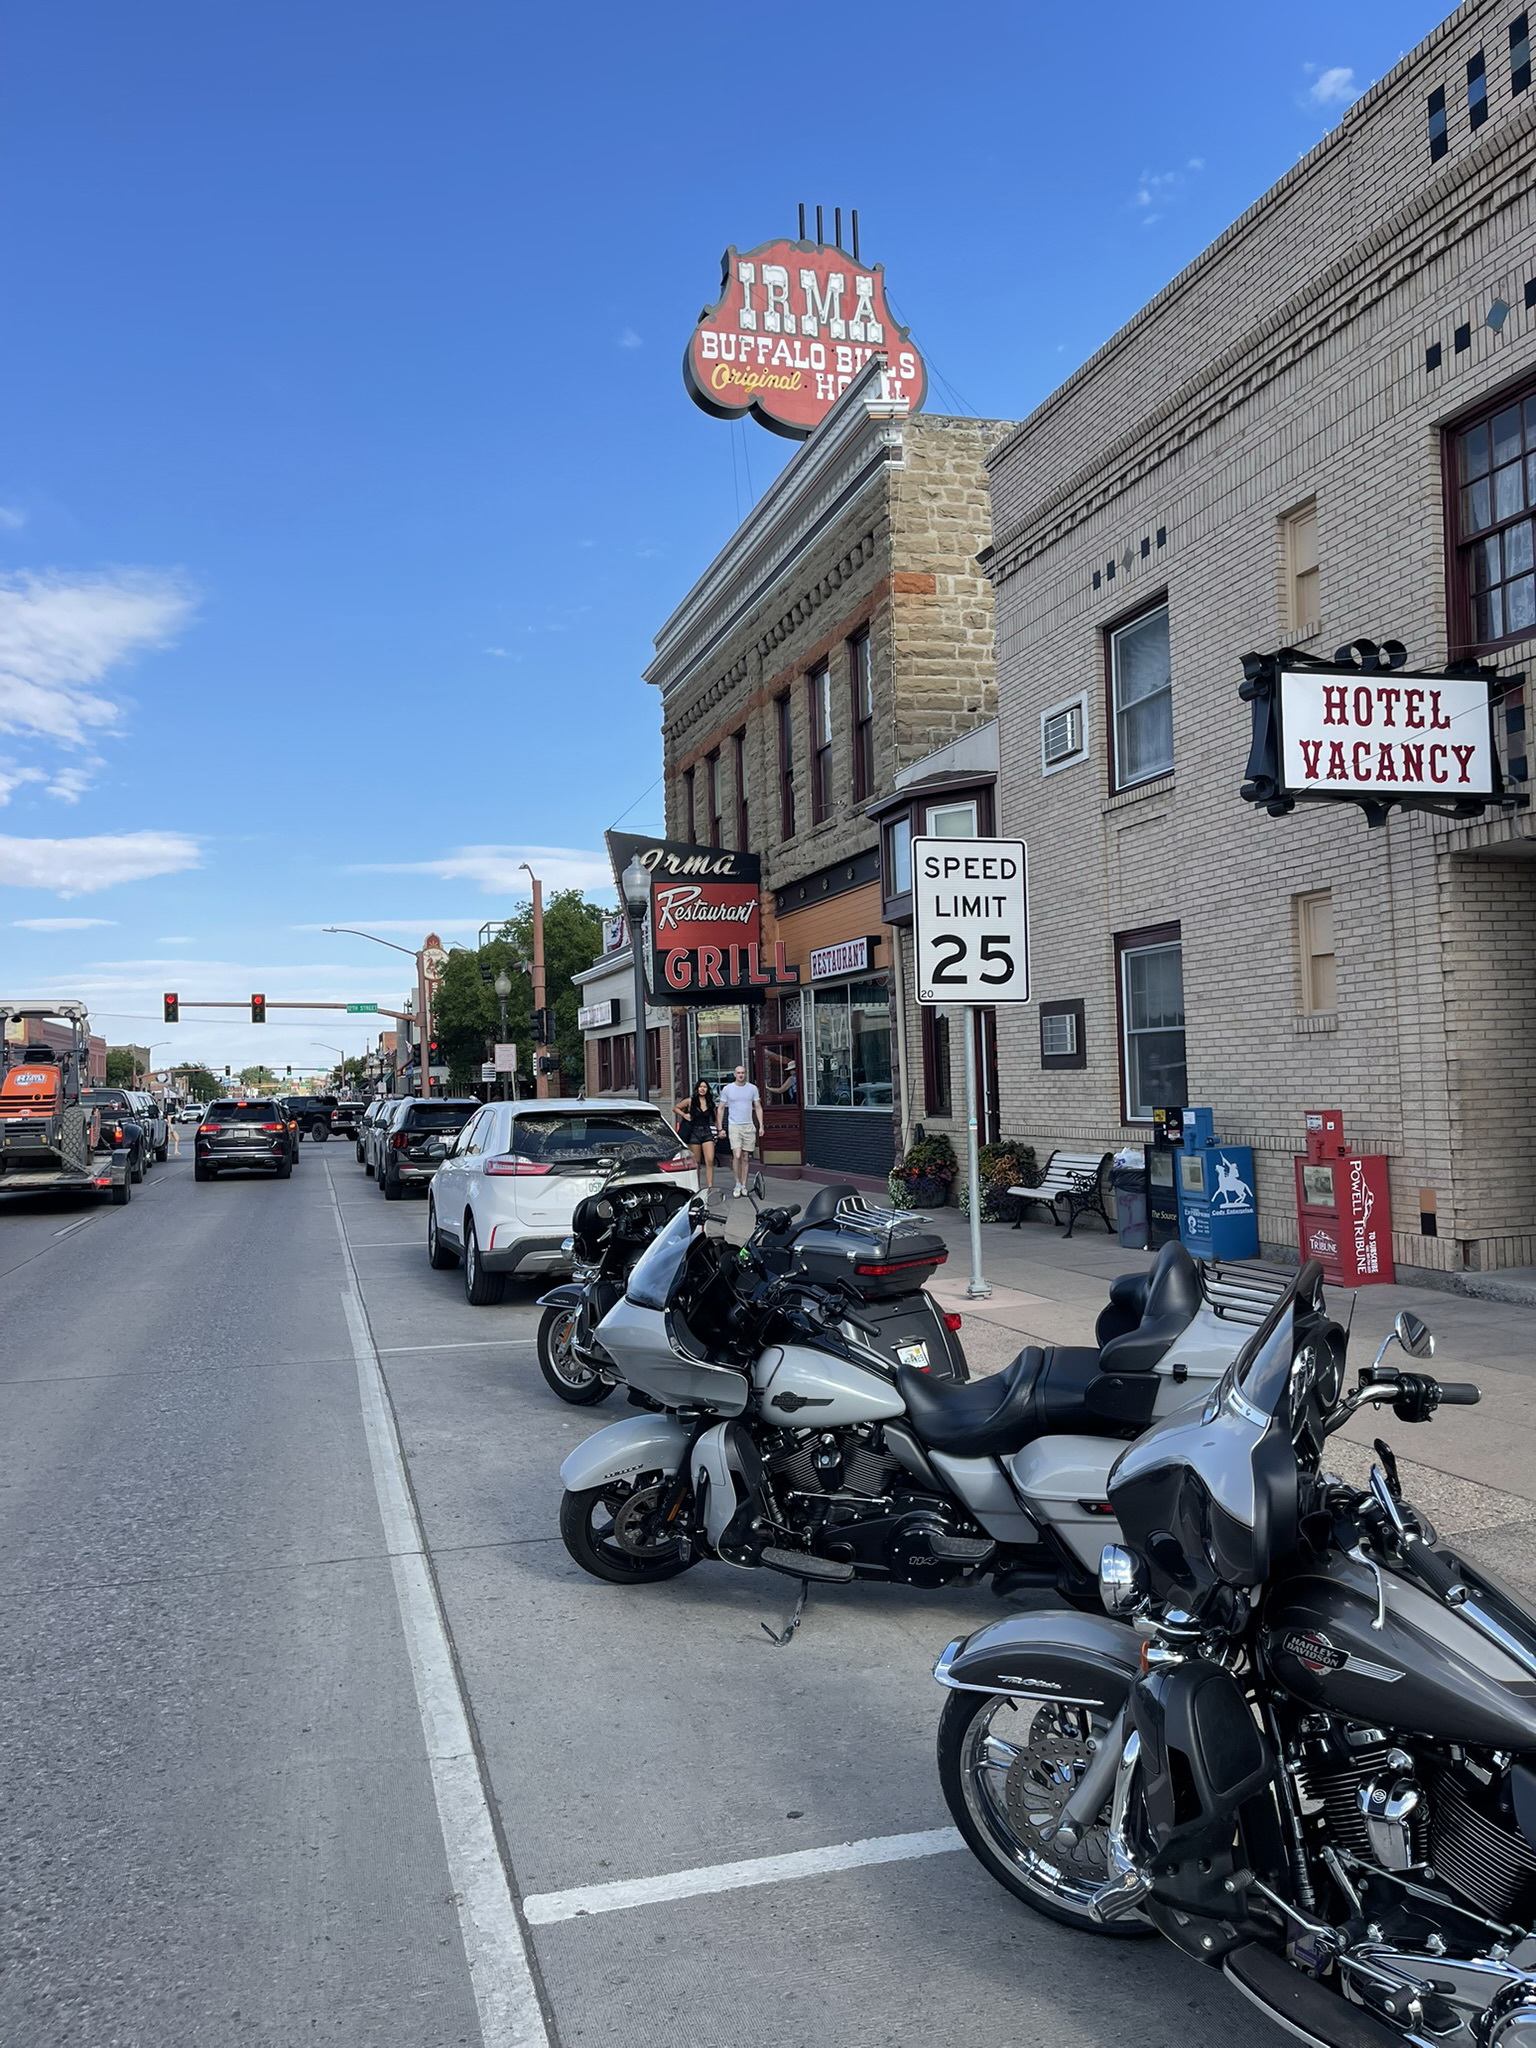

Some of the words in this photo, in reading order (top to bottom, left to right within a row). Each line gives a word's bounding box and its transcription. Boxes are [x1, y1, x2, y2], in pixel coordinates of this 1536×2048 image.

[737, 262, 883, 344] IRMA
[701, 330, 826, 371] BUFFALO
[711, 363, 802, 393] Original
[815, 373, 909, 400] HOL
[1322, 685, 1451, 729] HOTEL
[1299, 739, 1476, 784] VACANCY
[640, 848, 741, 876] Irma
[924, 856, 1017, 880] SPEED
[657, 885, 759, 931] Restaurant
[935, 895, 1007, 918] LIMIT
[665, 940, 798, 989] GRILL
[812, 942, 865, 977] RESTAURANT
[931, 934, 1015, 985] 25
[921, 989, 934, 998] 20
[1349, 1160, 1363, 1216] POWELL
[1151, 1209, 1161, 1219] The
[1161, 1211, 1178, 1220] Source
[1309, 1238, 1338, 1253] TRIBUNE
[1354, 1219, 1367, 1275] TRIBUNE
[1368, 1231, 1376, 1241] TO
[1369, 1241, 1379, 1274] SUBSCRIBE
[908, 1555, 939, 1566] 114
[1287, 1641, 1339, 1667] DAVIDSON
[1291, 1636, 1339, 1658] HARLEY-
